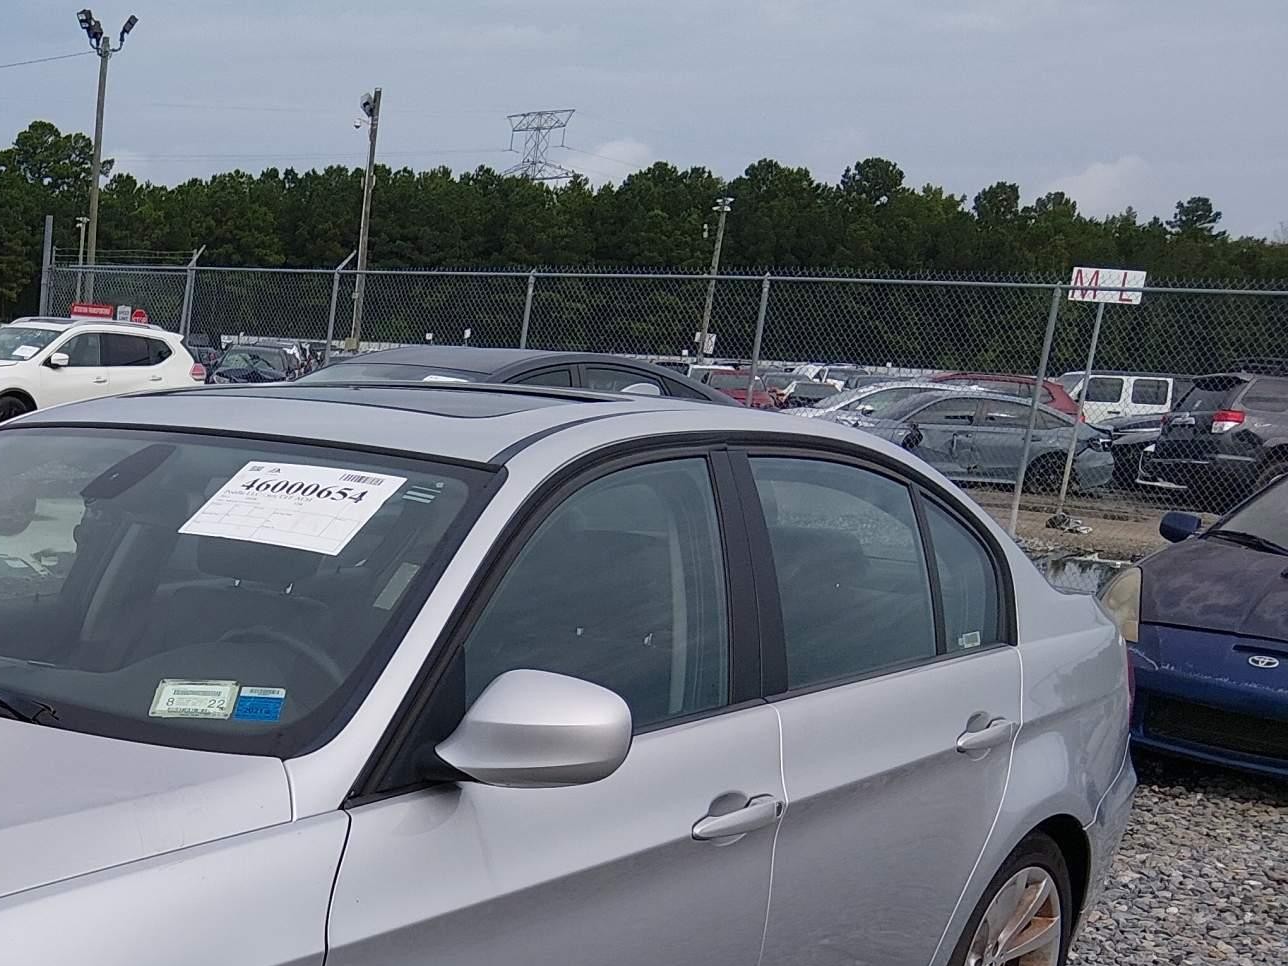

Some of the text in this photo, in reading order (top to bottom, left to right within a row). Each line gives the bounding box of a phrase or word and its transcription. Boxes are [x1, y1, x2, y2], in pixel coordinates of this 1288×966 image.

[1070, 269, 1133, 302] M L
[240, 477, 369, 505] 46000654
[207, 699, 225, 709] 22
